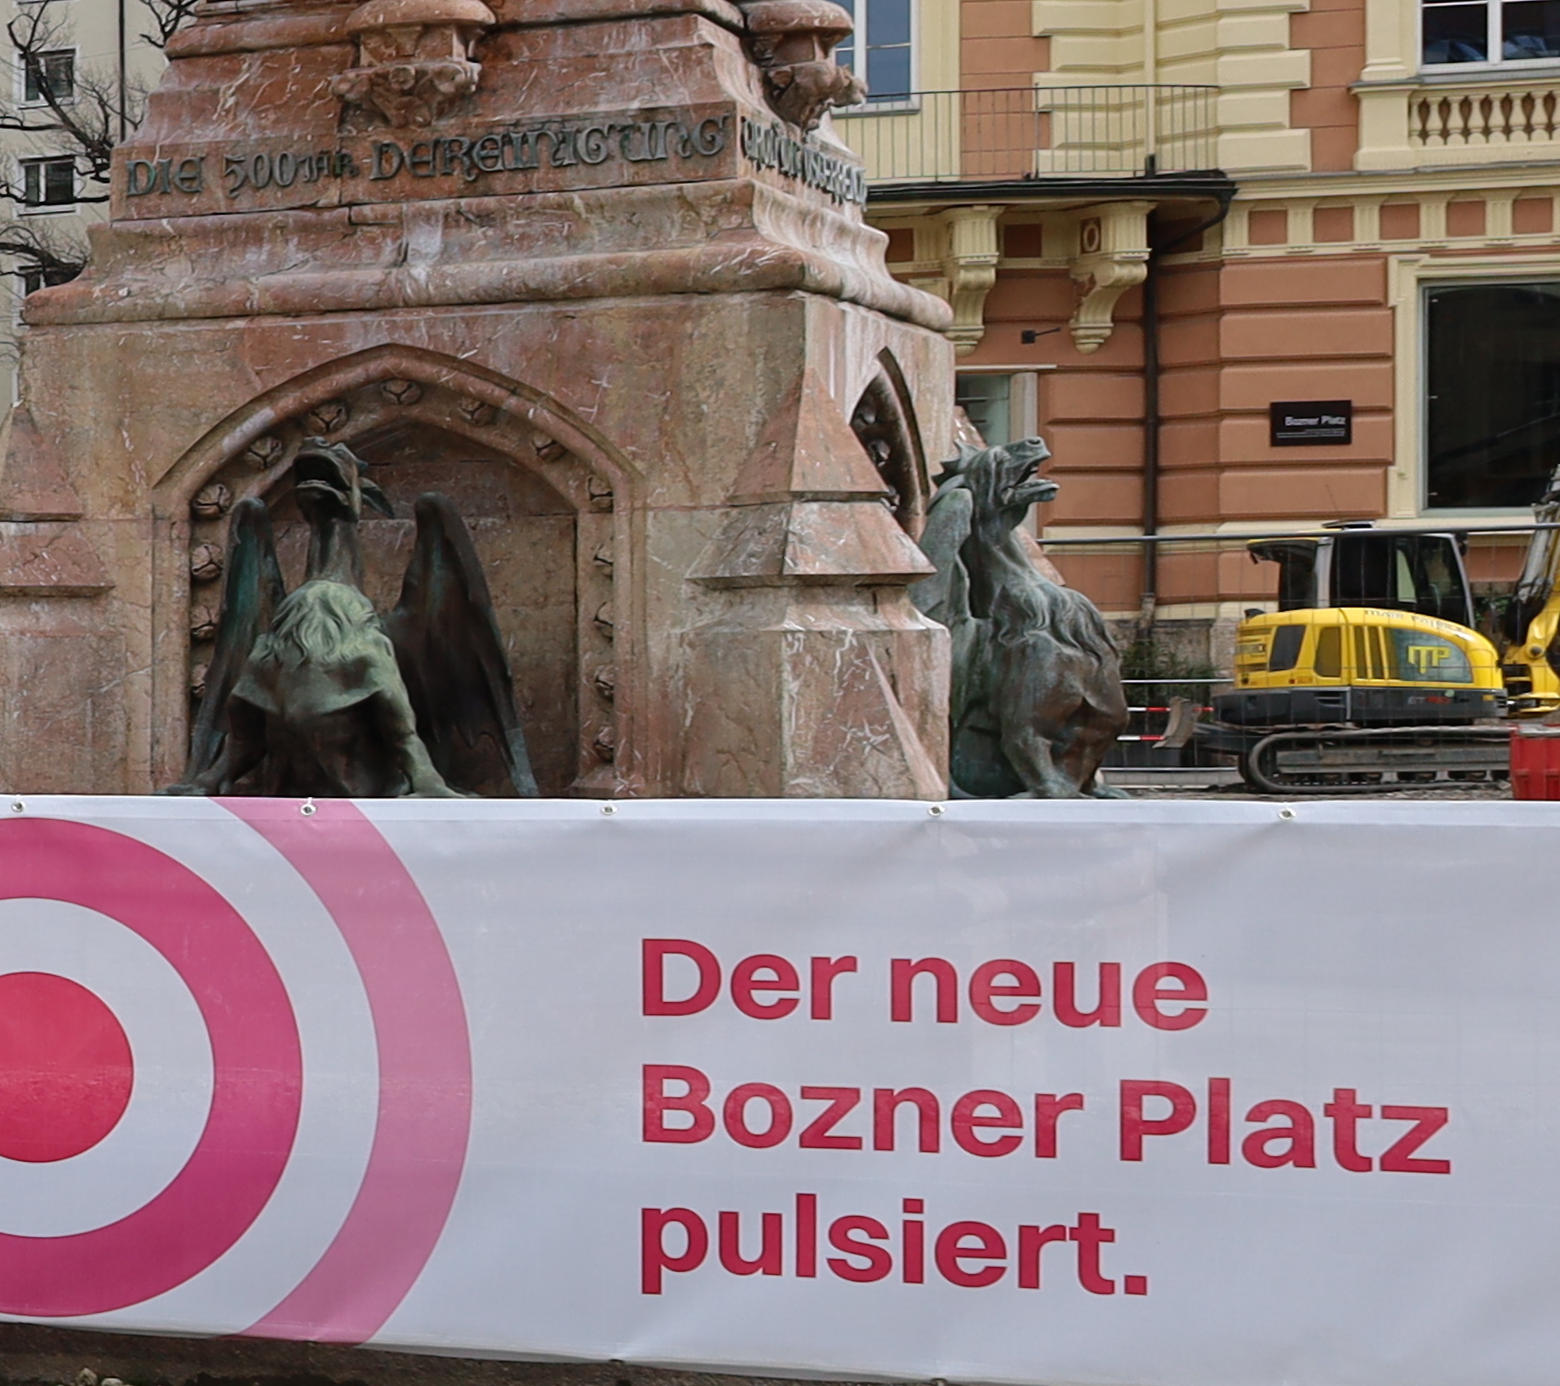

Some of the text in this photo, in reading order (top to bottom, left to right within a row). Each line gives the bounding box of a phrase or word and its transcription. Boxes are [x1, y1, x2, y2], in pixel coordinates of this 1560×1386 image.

[125, 153, 205, 198] DIE
[640, 936, 1210, 1032] Der neue
[640, 1063, 1453, 1176] Bozner Platz
[639, 1191, 1149, 1297] pulsiert.
